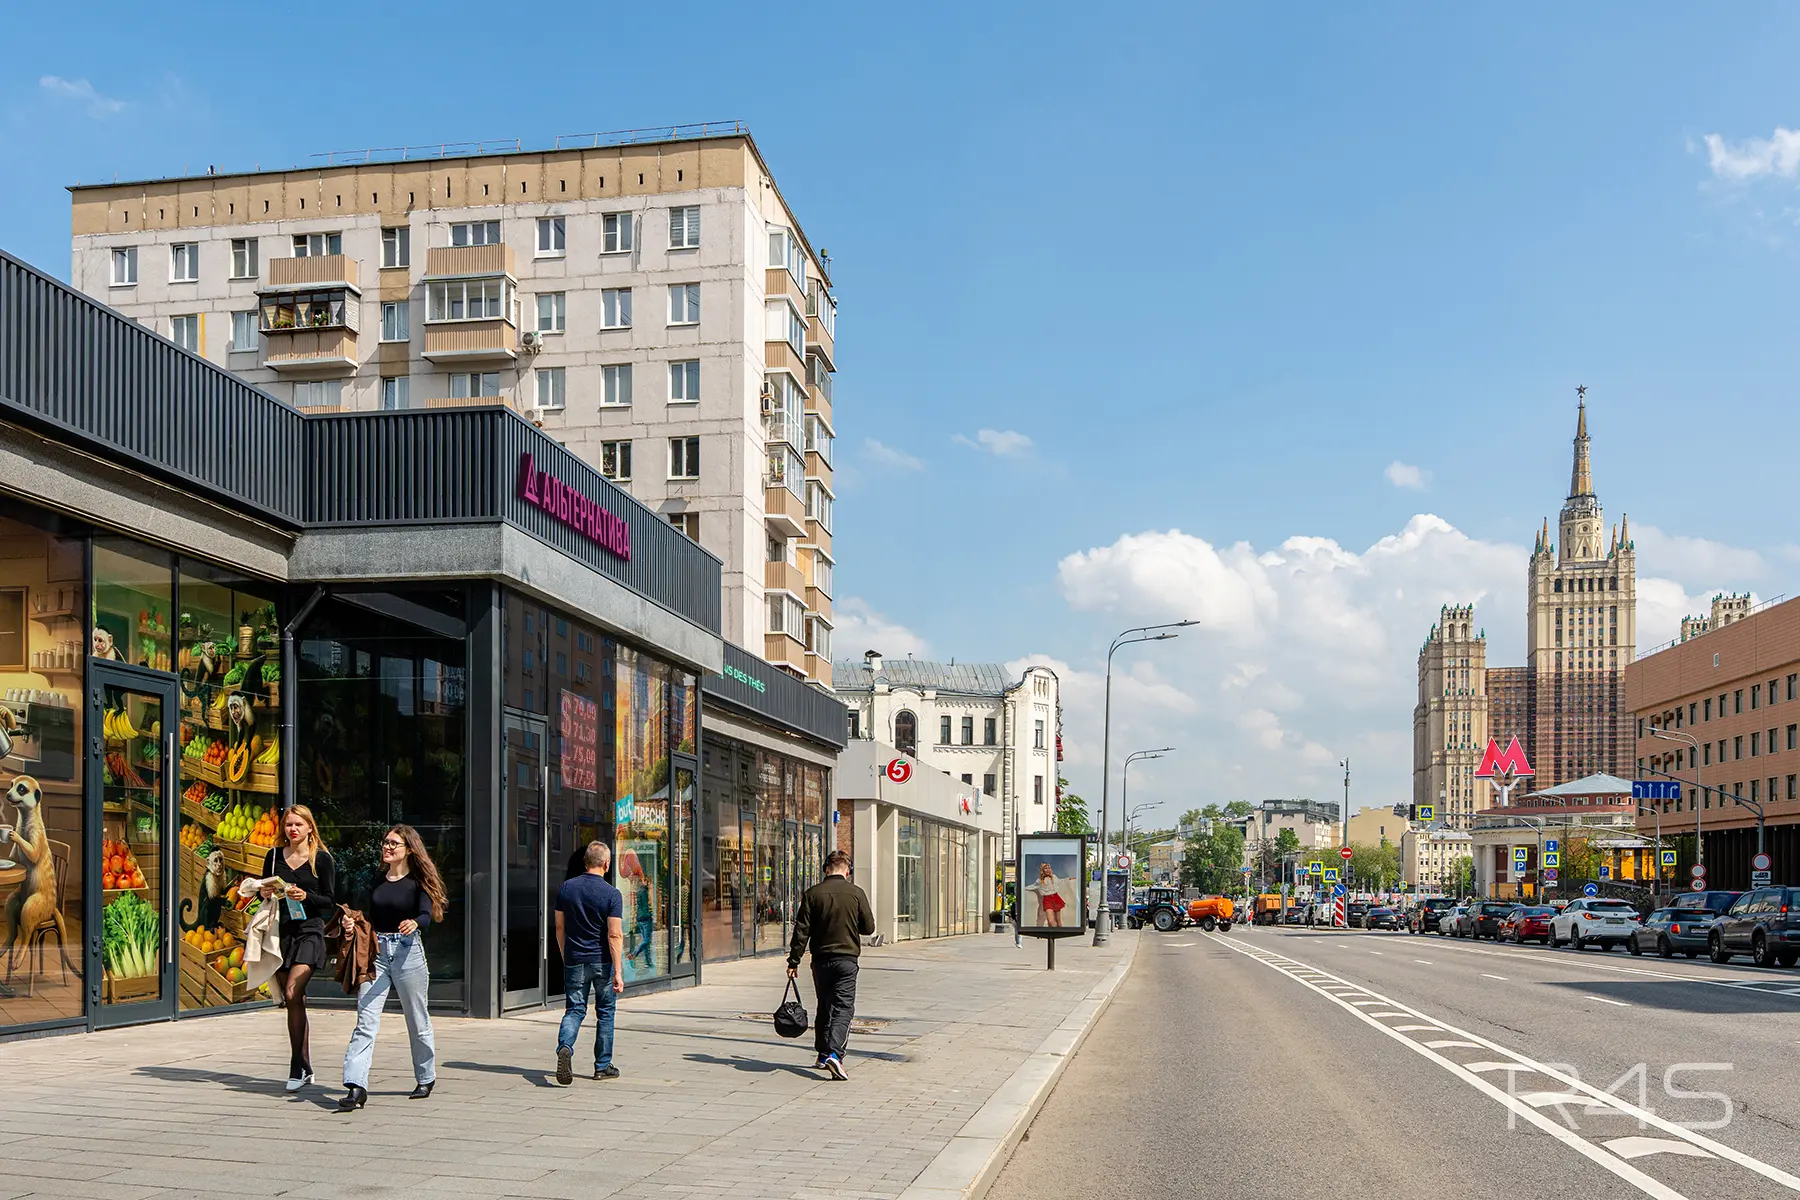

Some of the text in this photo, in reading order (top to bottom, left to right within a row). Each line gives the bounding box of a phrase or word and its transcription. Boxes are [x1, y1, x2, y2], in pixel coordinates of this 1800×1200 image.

[543, 472, 631, 561] АЛЬТЕРНАТИВА
[734, 668, 748, 684] DES
[634, 805, 666, 827] ПРЕСНЯ
